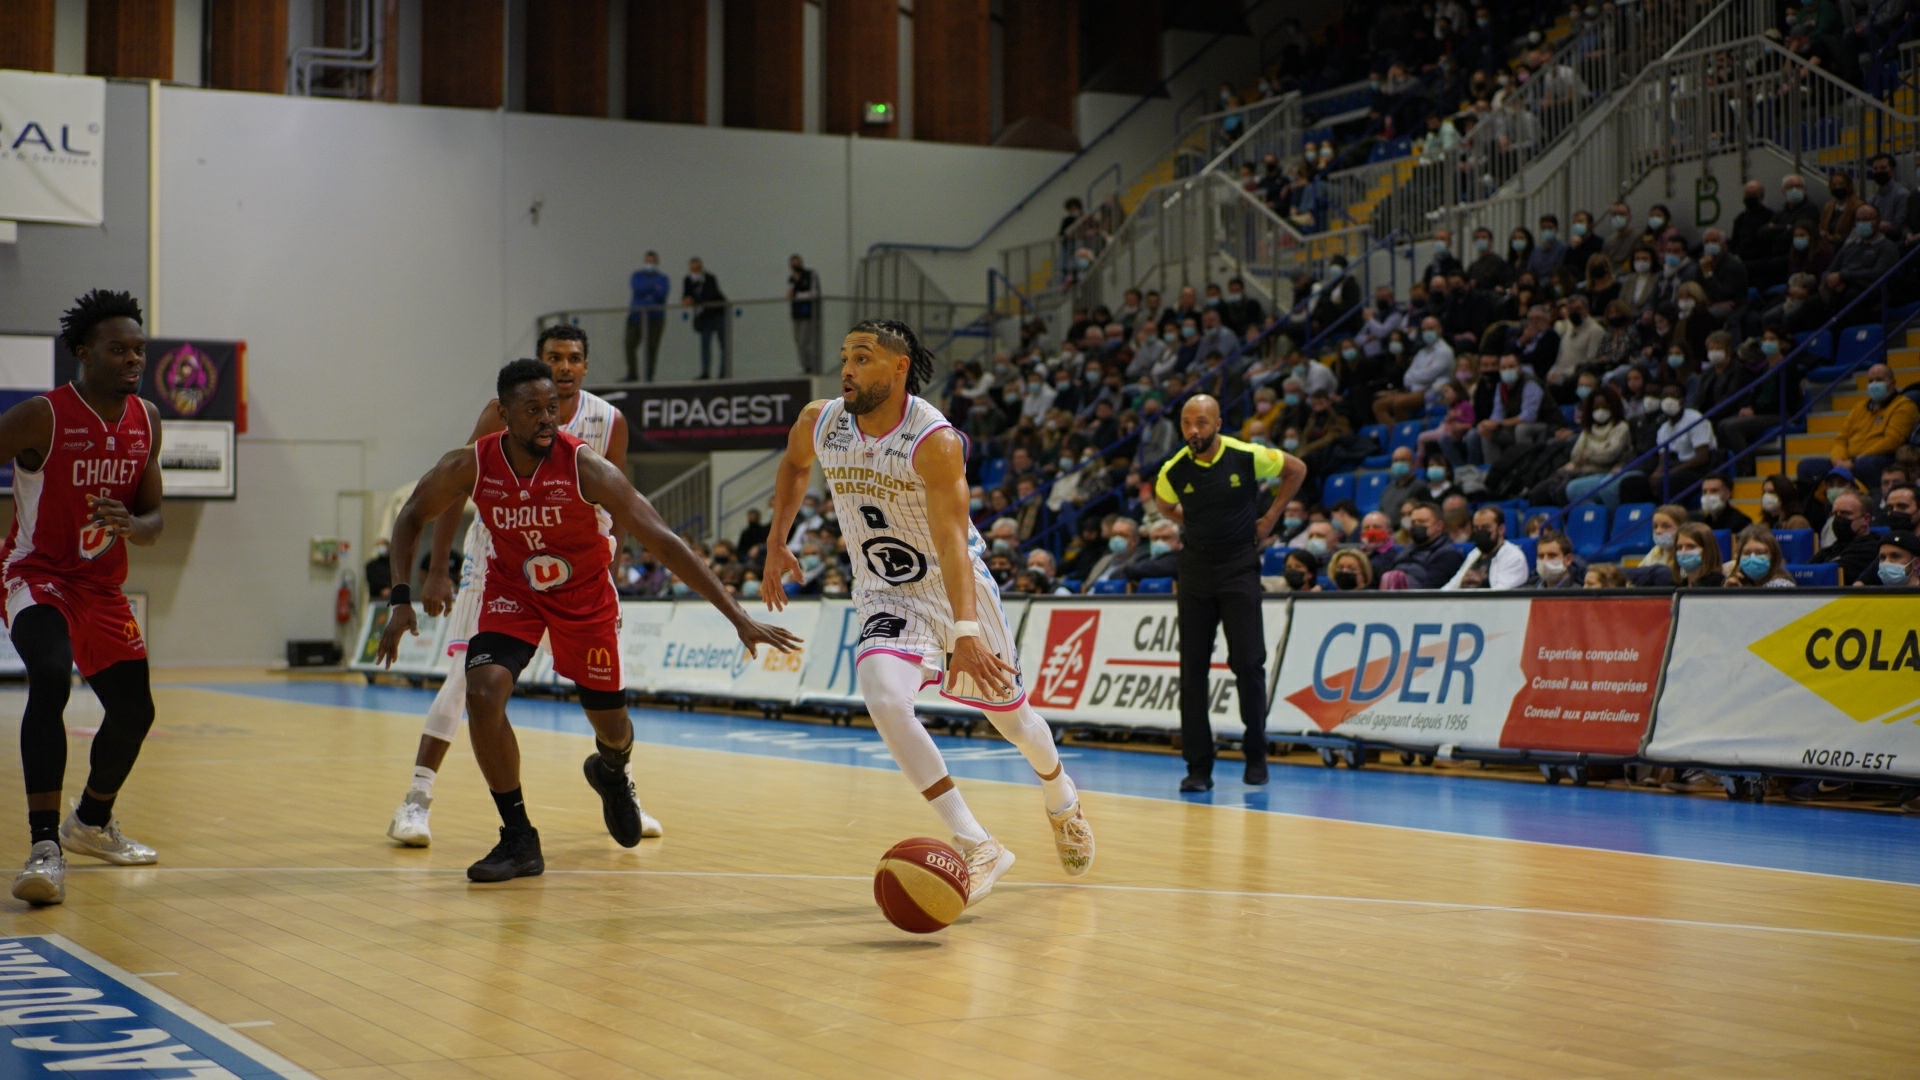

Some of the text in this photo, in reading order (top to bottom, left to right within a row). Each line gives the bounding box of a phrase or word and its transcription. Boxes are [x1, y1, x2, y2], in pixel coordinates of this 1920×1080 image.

[0, 121, 91, 156] AL
[1695, 176, 1721, 227] B
[641, 395, 791, 428] FIPAGEST
[72, 459, 138, 486] CHOLET
[834, 481, 899, 503] BASKET
[492, 506, 563, 530] CHOLET
[520, 530, 546, 550] 12
[762, 647, 805, 672] REIMS
[1312, 622, 1486, 705] CDER
[1538, 646, 1639, 663] Expertise comptable
[1532, 676, 1648, 694] Conseil aux entreprises
[1341, 709, 1470, 732] Conseil gagnant depuis 1956
[1524, 704, 1640, 723] Conseil aux particuliers
[1802, 749, 1897, 771] NORD-EST
[11, 1028, 246, 1080] AC
